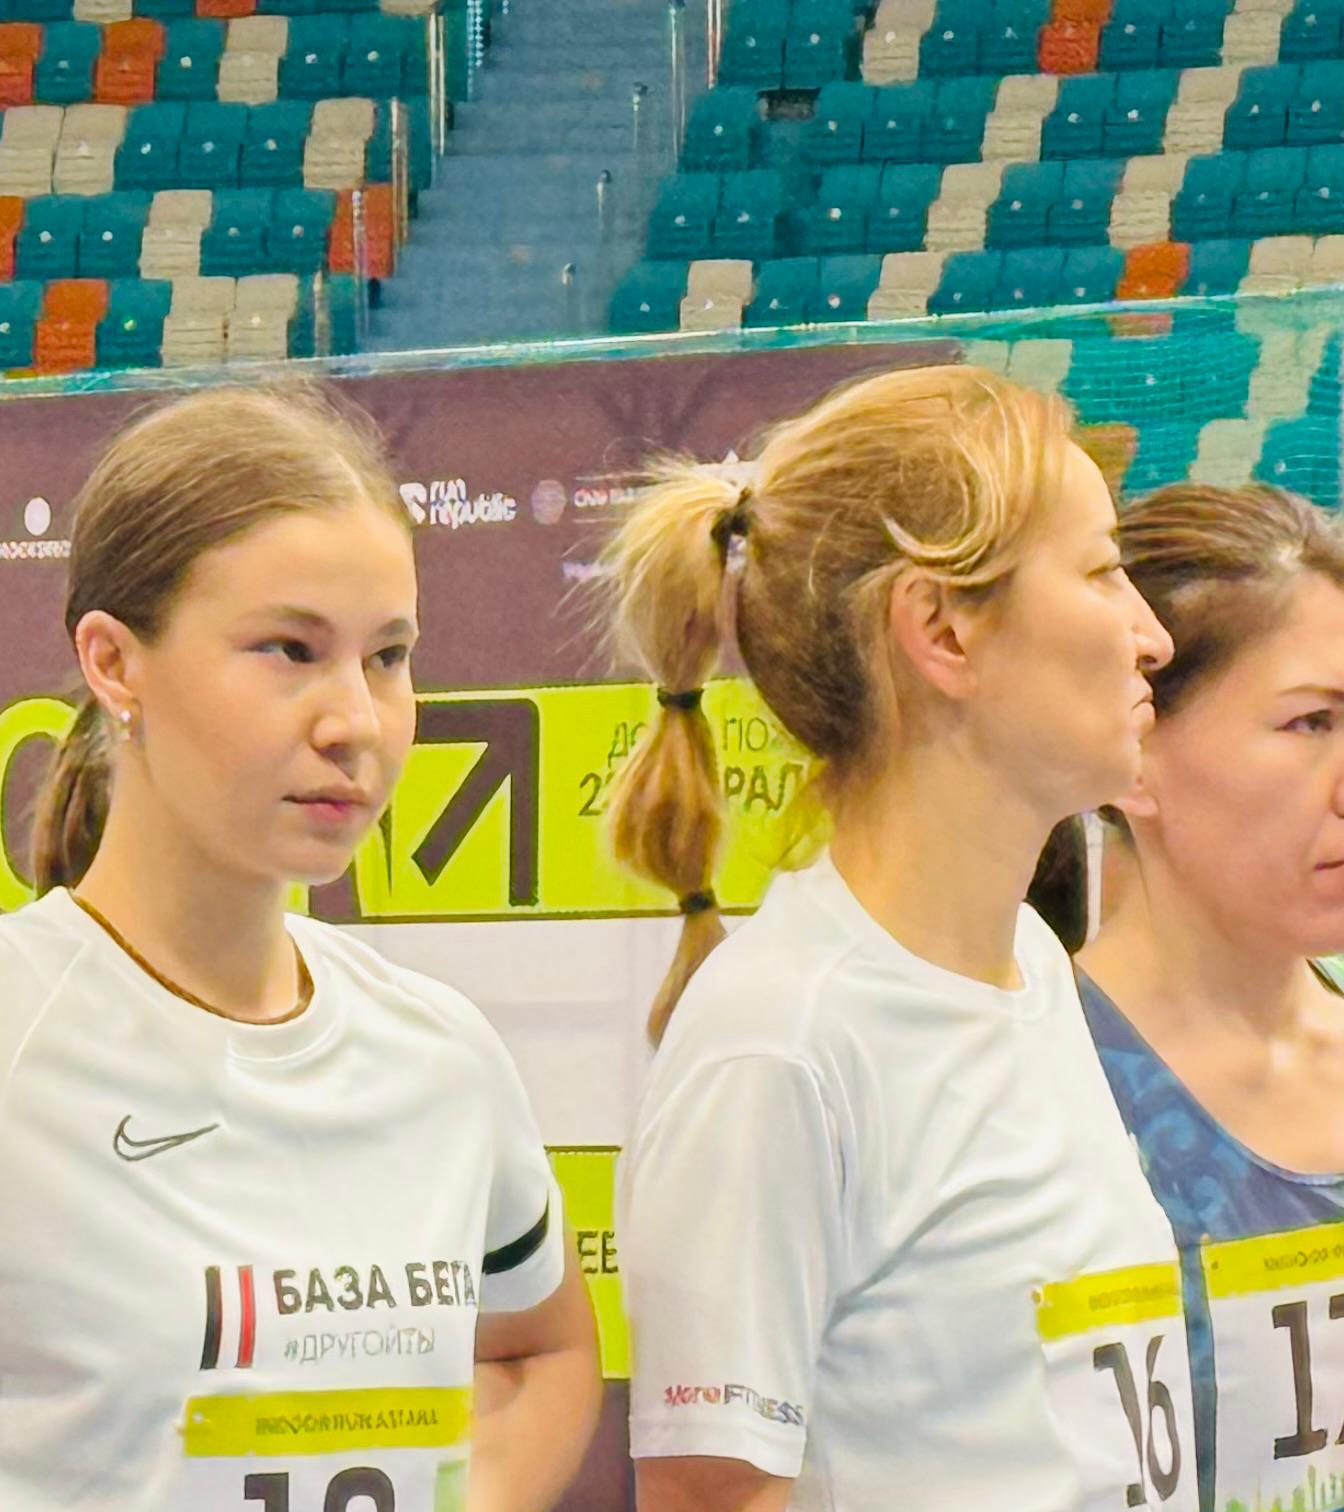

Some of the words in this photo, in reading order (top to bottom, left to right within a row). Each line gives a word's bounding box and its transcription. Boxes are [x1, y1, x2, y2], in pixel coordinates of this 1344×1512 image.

[273, 1264, 396, 1315] БАЗА
[405, 1260, 476, 1306] БЕГА
[284, 1326, 435, 1364] #ДРУГОЙТЫ
[1092, 1335, 1181, 1508] 16
